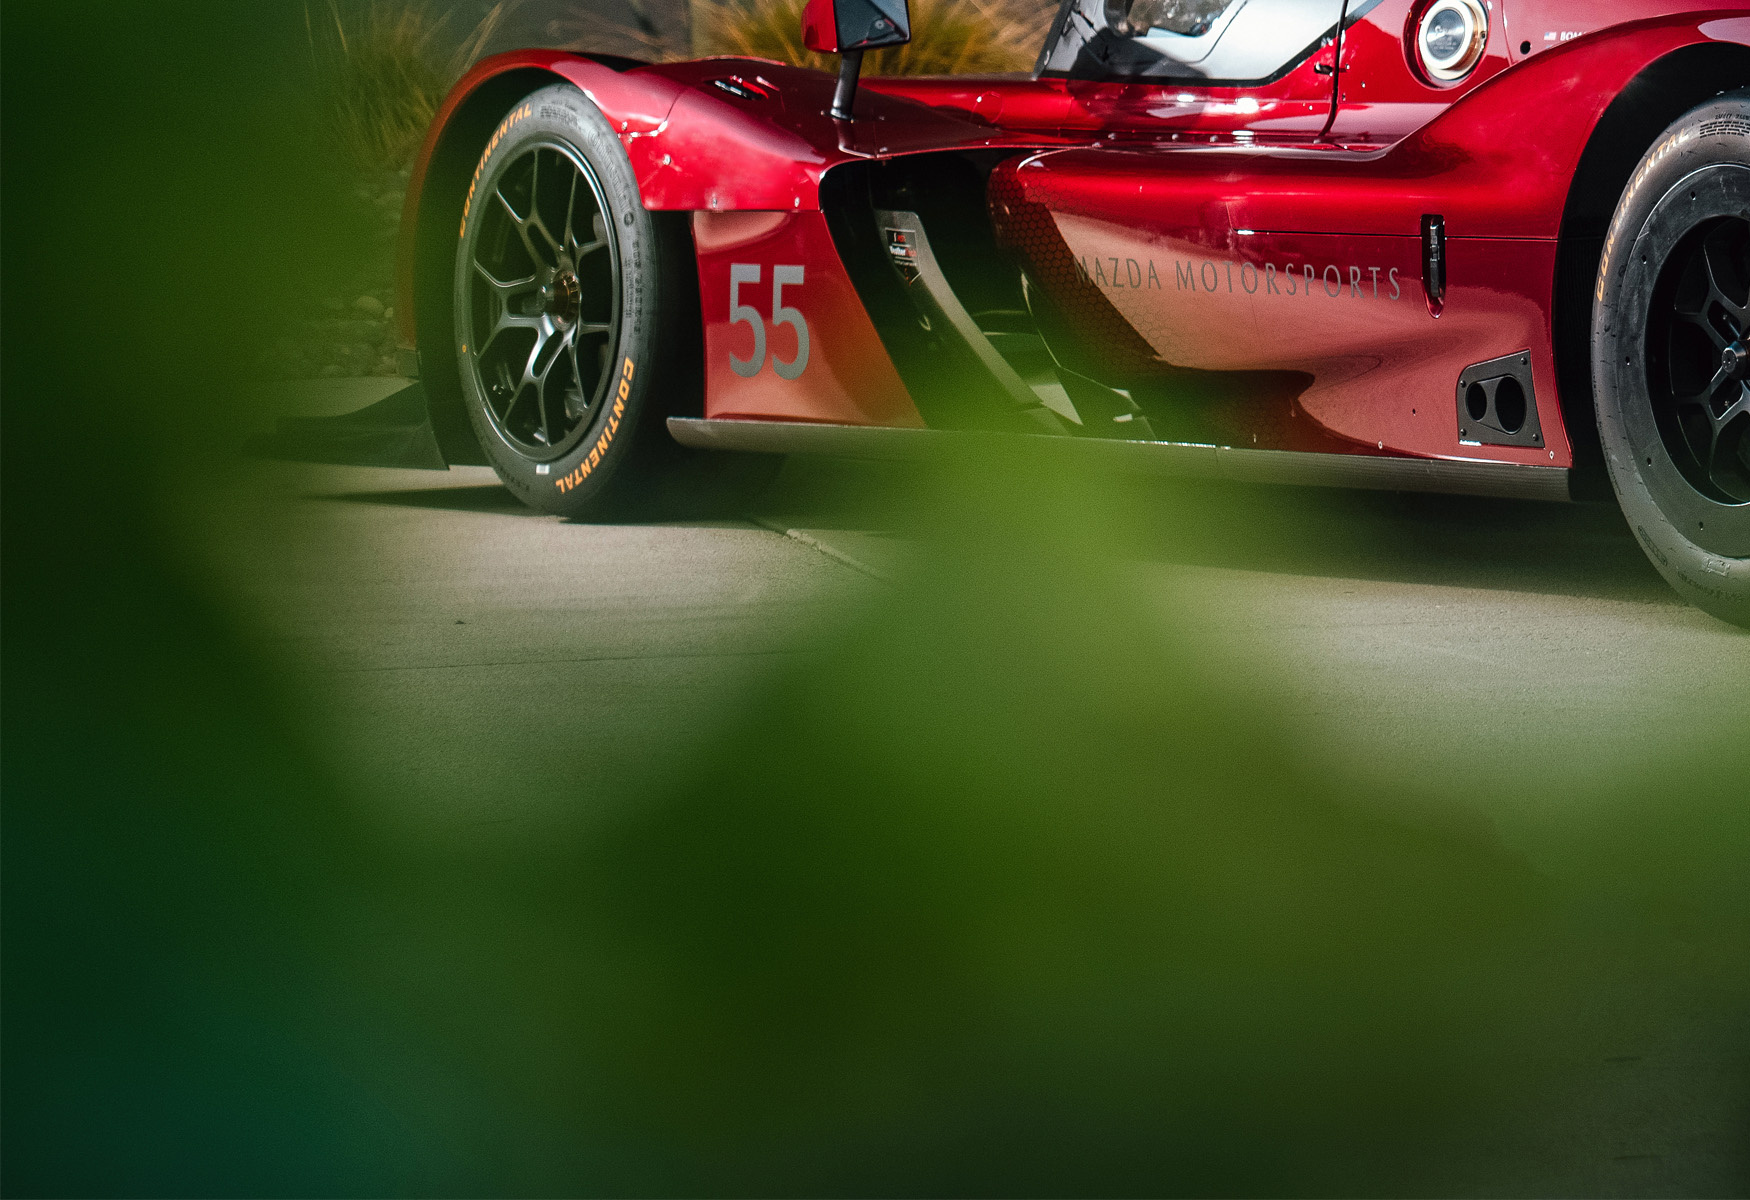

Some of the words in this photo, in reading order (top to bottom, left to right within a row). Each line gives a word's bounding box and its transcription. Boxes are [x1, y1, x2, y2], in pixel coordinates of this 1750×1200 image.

[459, 103, 532, 239] CONTINENTAL
[1596, 128, 1690, 302] CONTINENTAL
[729, 262, 810, 381] 55
[1073, 255, 1162, 290] MAZDA
[1175, 260, 1401, 301] MOTORSPORTS
[555, 356, 635, 495] CONTINENTAL
